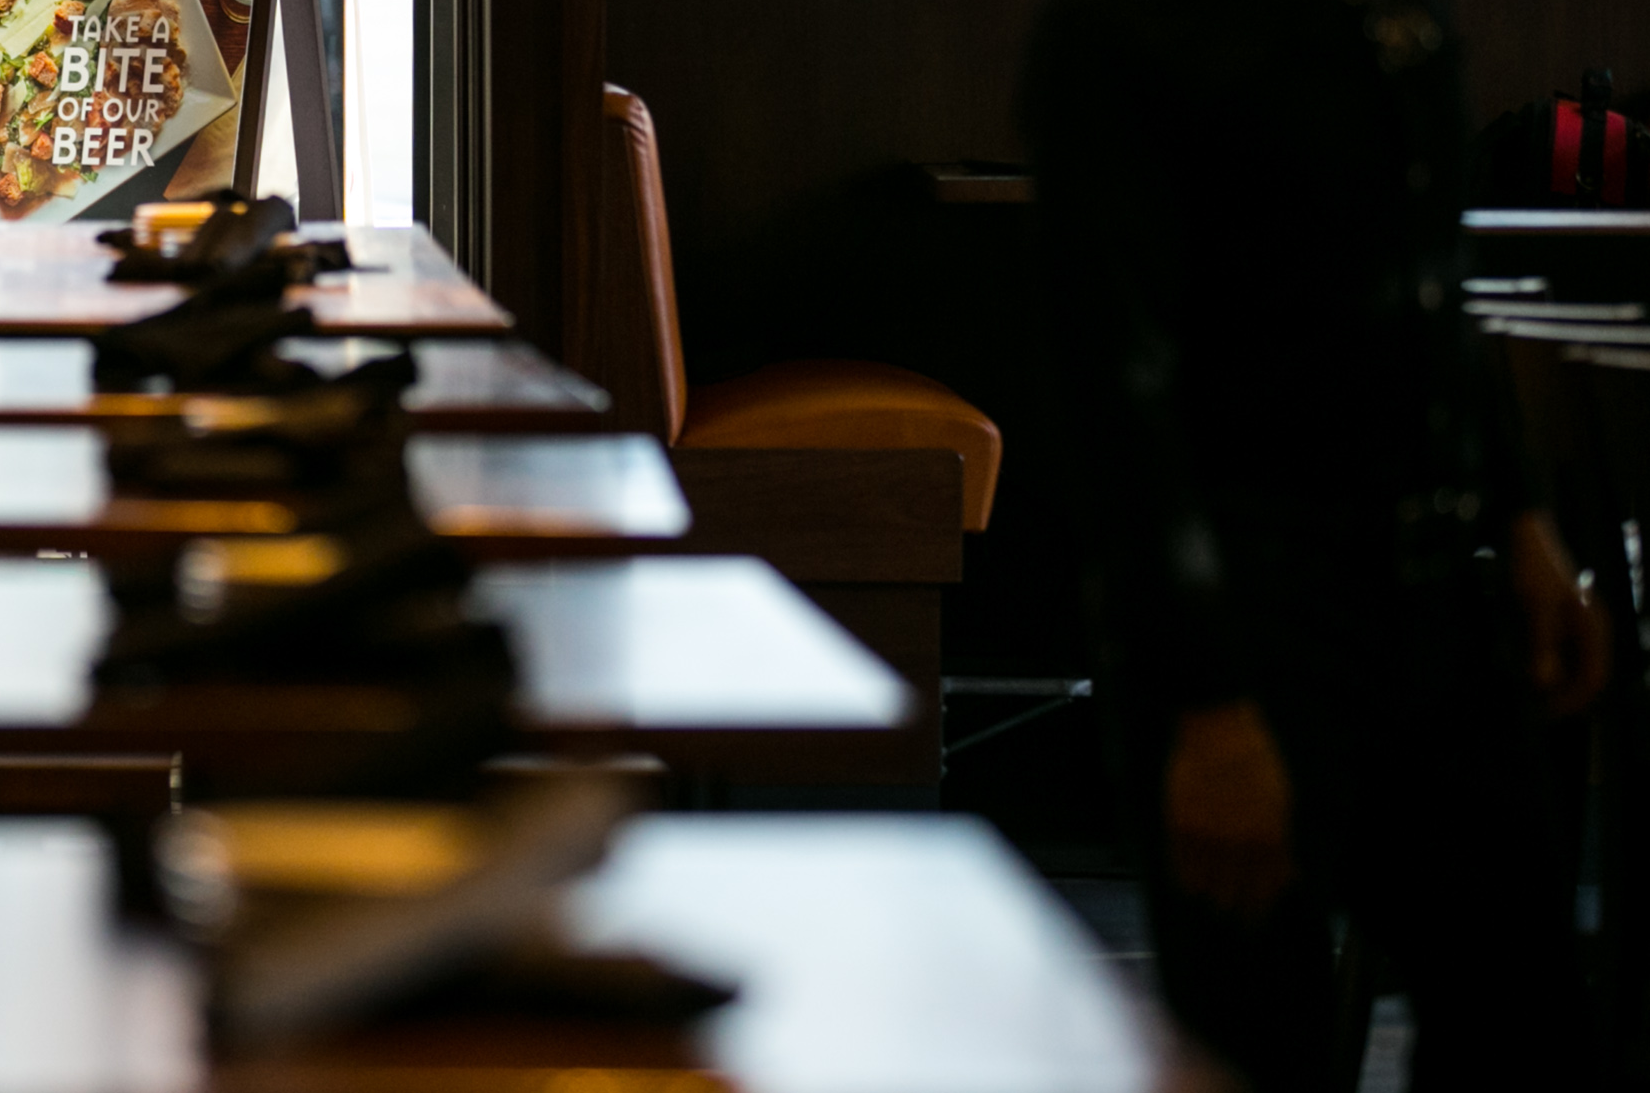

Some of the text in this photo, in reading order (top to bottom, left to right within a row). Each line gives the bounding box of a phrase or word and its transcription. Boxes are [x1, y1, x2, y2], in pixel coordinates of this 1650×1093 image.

[68, 15, 170, 43] TAKE A
[60, 47, 167, 93] BITE
[58, 97, 159, 122] OF OUR
[52, 126, 155, 166] BEER
